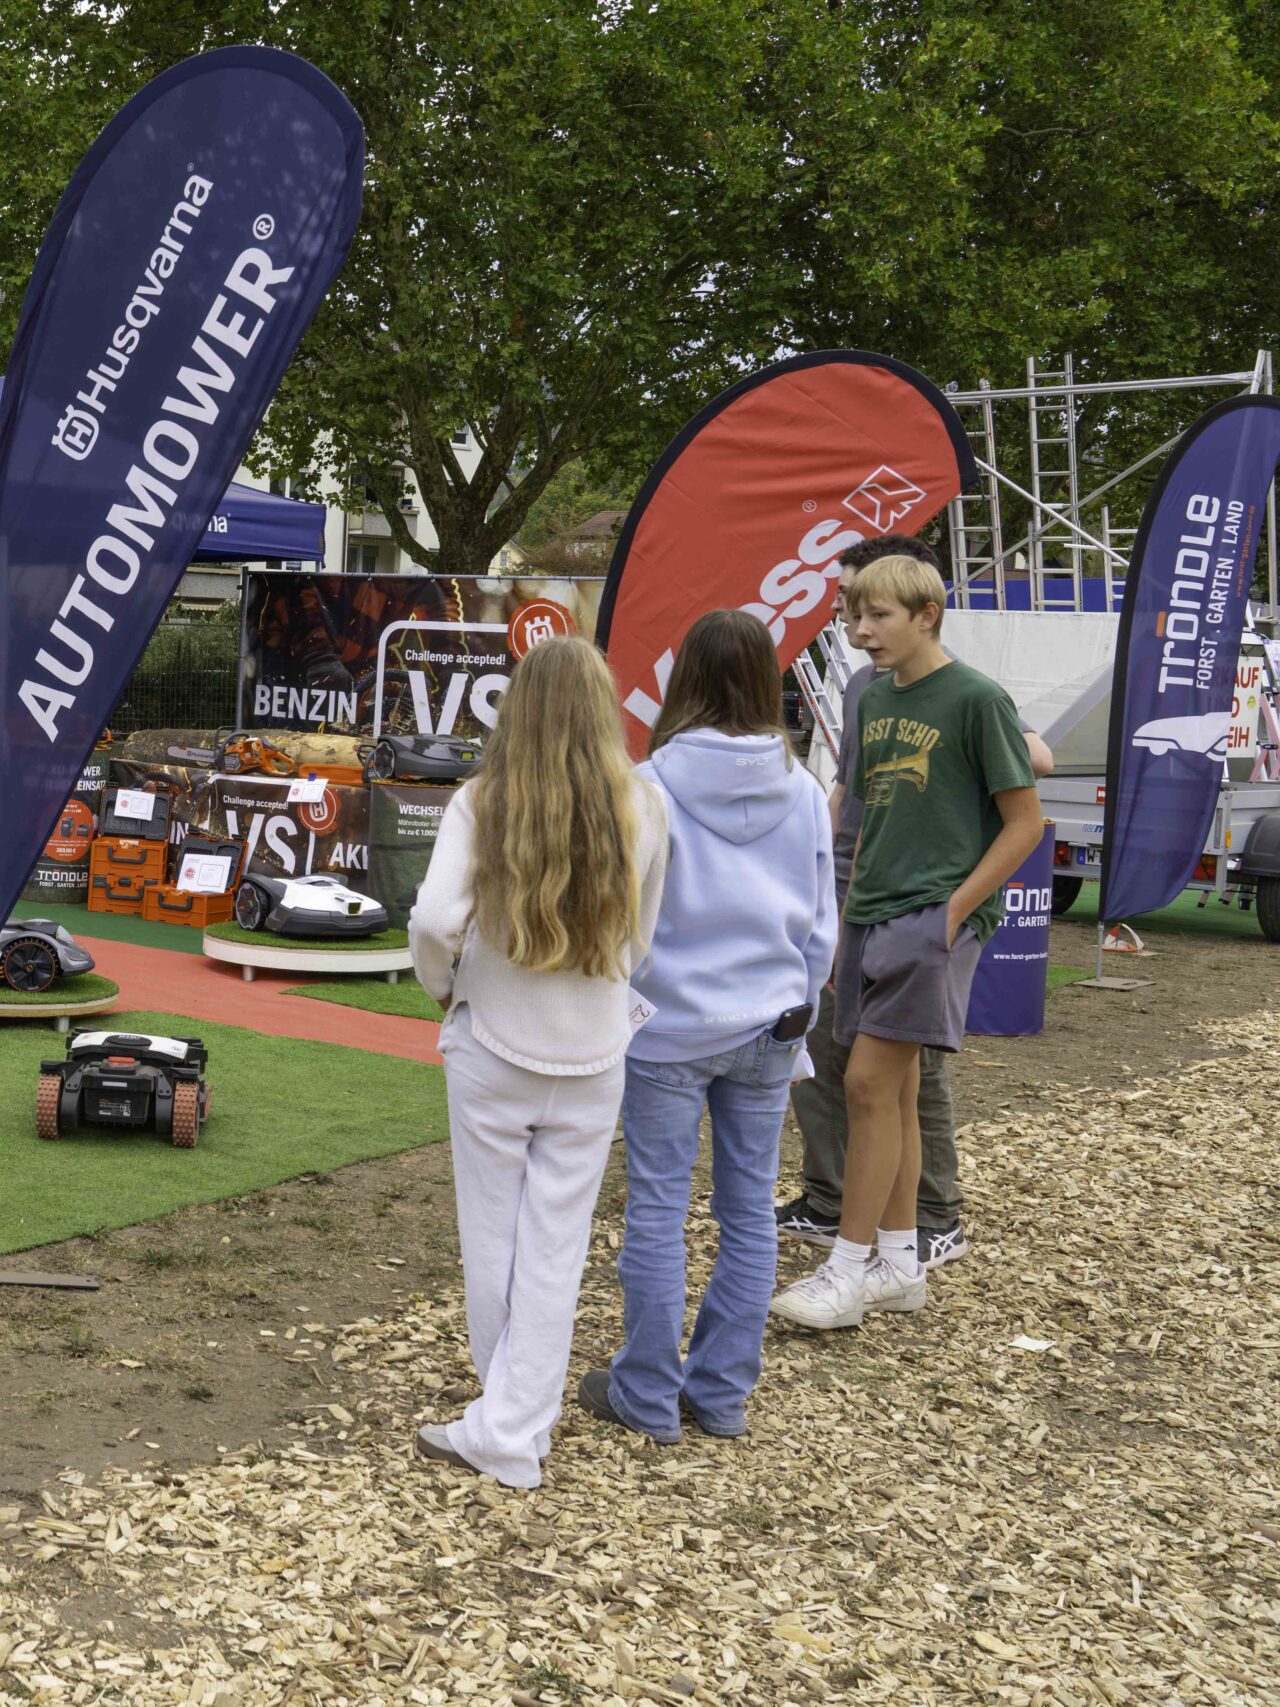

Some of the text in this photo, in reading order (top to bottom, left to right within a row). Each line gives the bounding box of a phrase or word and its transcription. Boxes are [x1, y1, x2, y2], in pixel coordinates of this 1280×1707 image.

[1196, 500, 1244, 690] FORST GARTEN LAND
[405, 649, 506, 666] Challenge accepted!
[254, 685, 358, 724] BENZIN
[408, 670, 513, 736] VS
[223, 794, 289, 810] Challenge accepted!
[225, 810, 298, 875] VS
